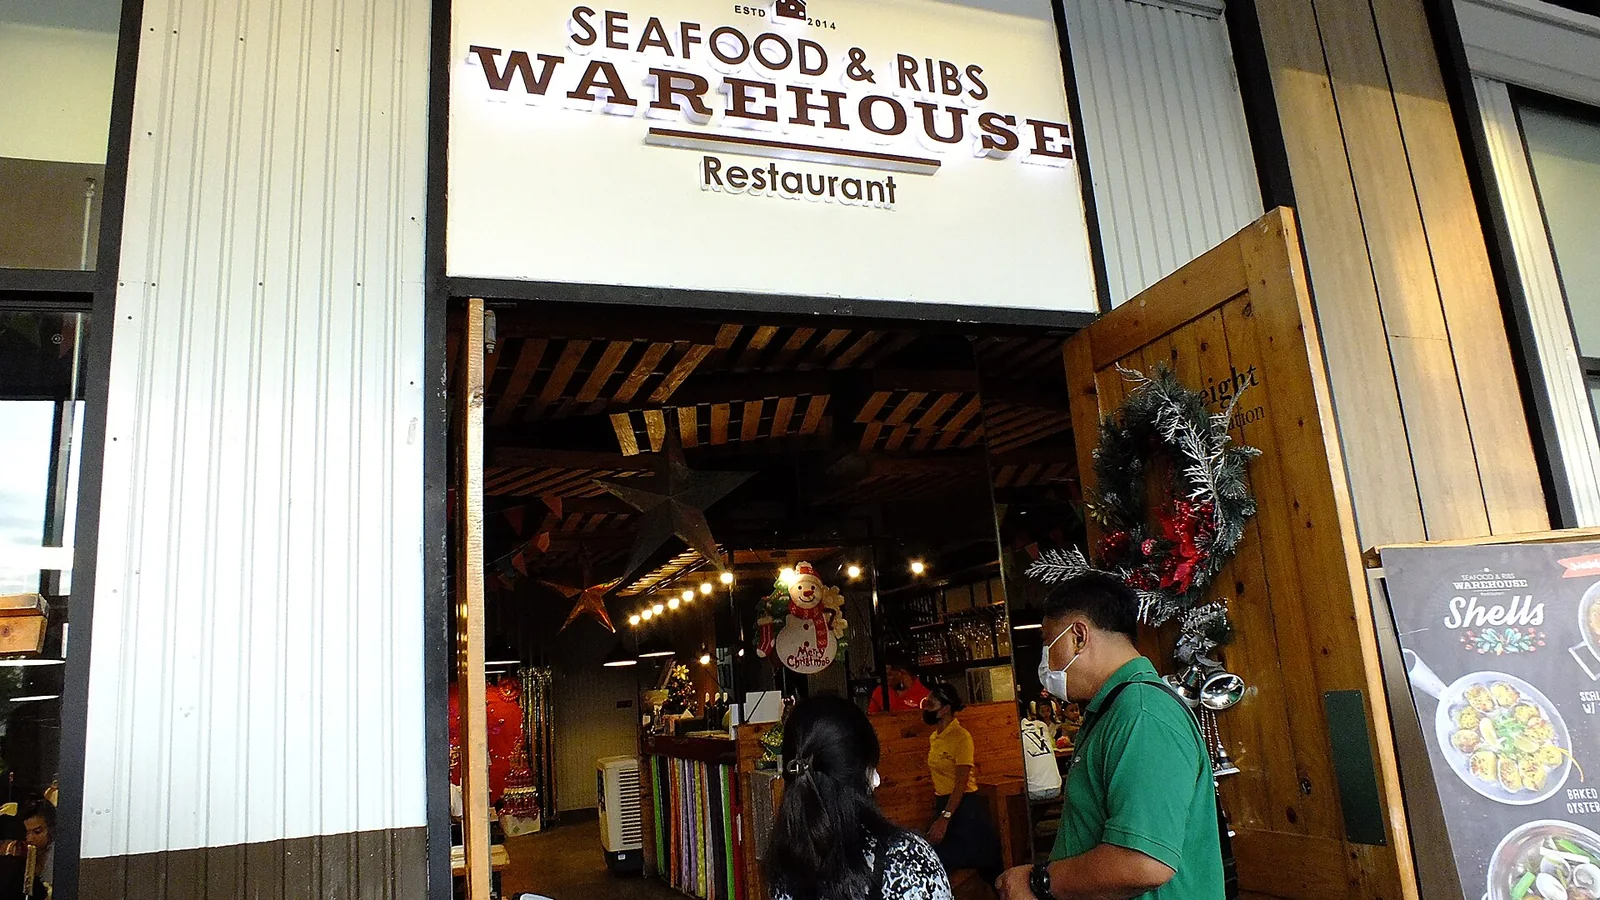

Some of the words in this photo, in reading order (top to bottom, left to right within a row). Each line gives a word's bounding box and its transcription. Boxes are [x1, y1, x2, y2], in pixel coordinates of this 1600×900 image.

[734, 5, 766, 18] ESTD
[807, 17, 836, 30] 2014
[570, 6, 828, 76] SEAFOOD
[846, 47, 876, 84] &
[897, 53, 989, 101] RIBS
[468, 45, 1073, 159] WAREHOUSE
[703, 155, 897, 204] Restaurant
[1198, 364, 1260, 409] eight
[1452, 579, 1528, 590] WAREHOUSE
[1444, 595, 1545, 629] Shells
[787, 655, 830, 668] Christmas
[797, 646, 825, 658] Merry
[1566, 787, 1598, 800] BAKED
